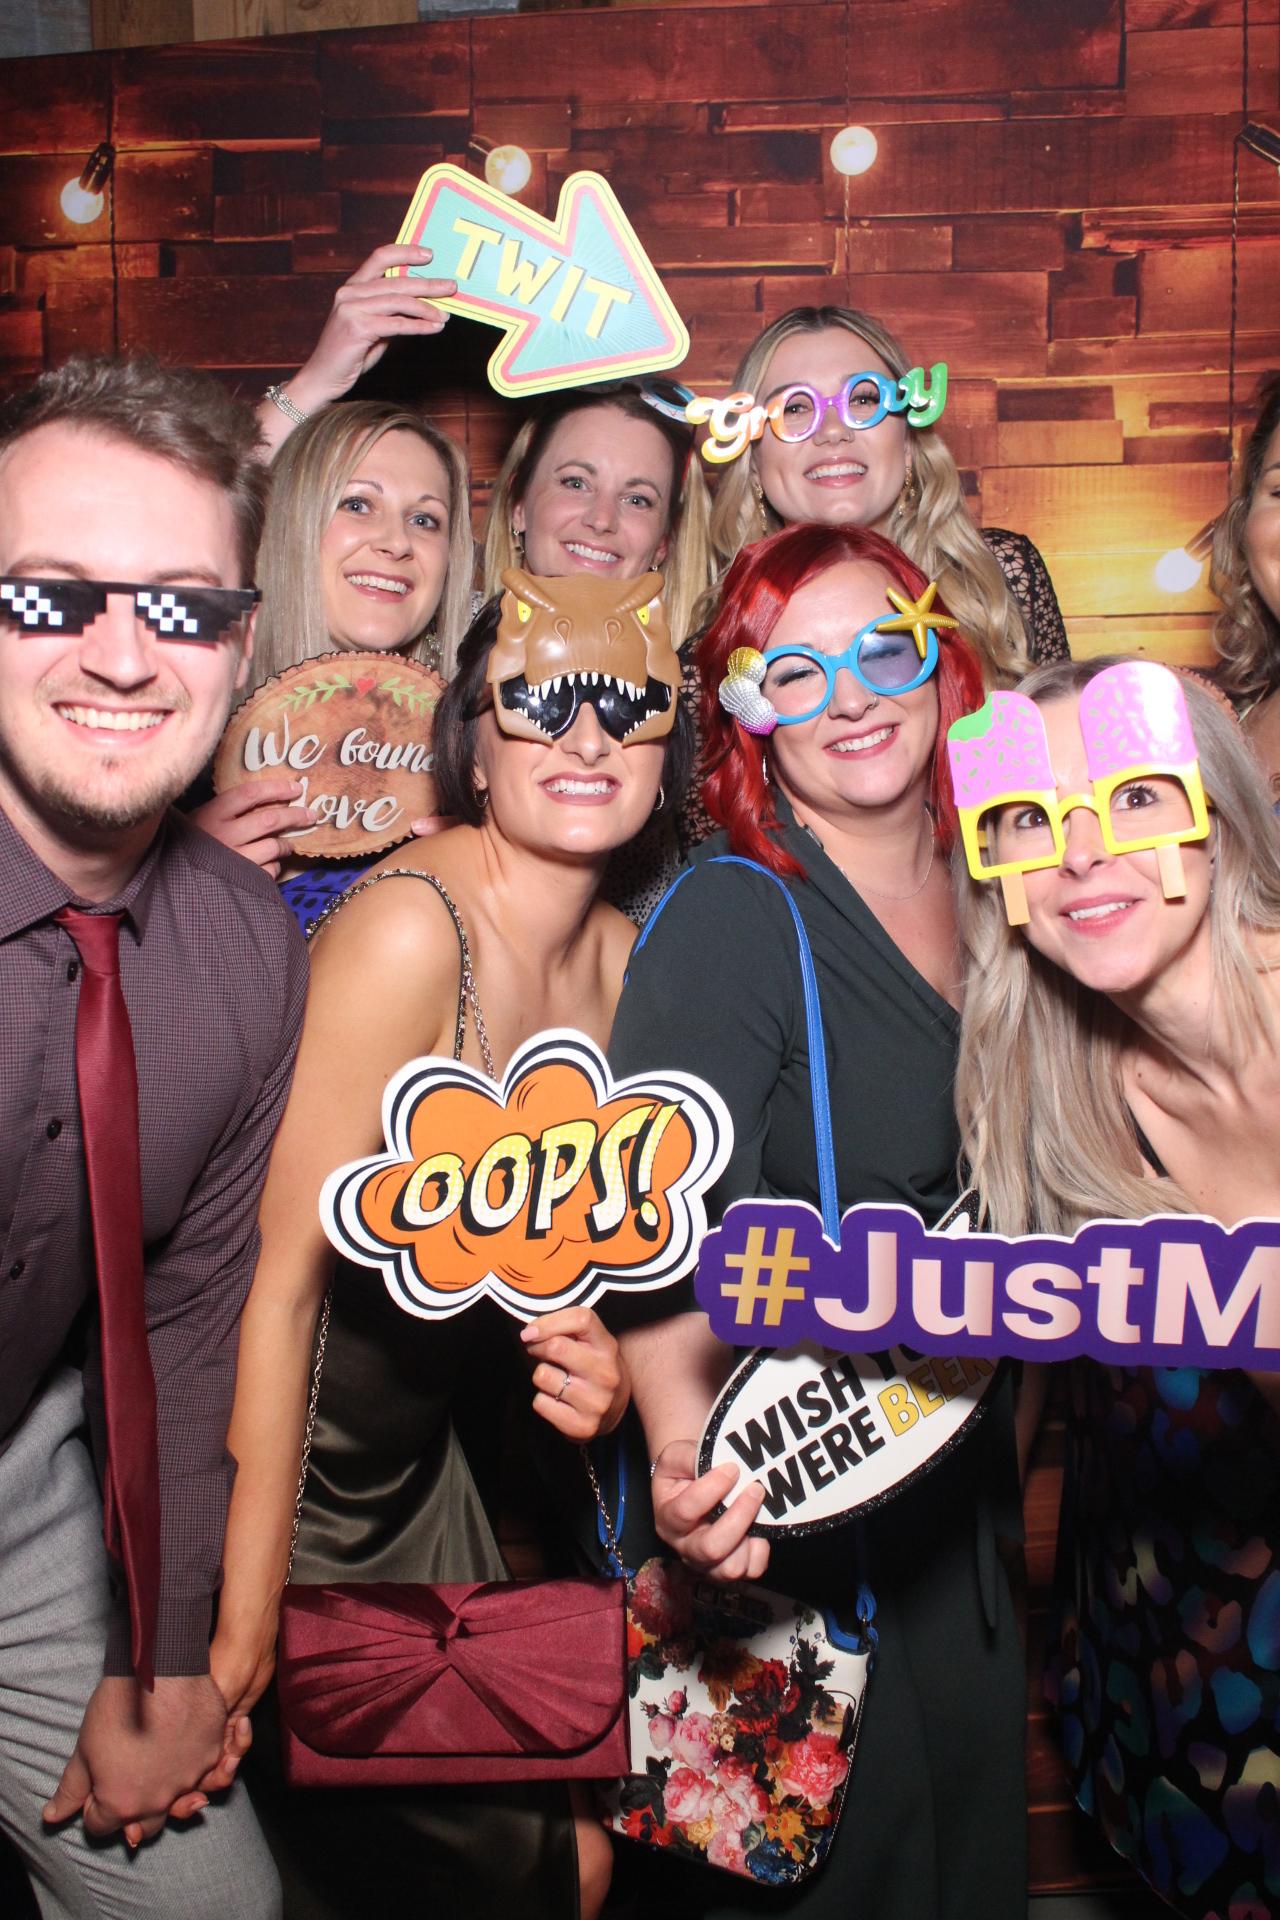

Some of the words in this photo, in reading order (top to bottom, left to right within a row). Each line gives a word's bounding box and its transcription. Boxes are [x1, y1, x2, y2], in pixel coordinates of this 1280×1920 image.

[453, 218, 633, 340] TWIT
[244, 712, 327, 772] We
[391, 1100, 684, 1243] OOPS!
[720, 1226, 1280, 1349] #JustM
[725, 1357, 866, 1472] WISH
[757, 1406, 886, 1520] WERE
